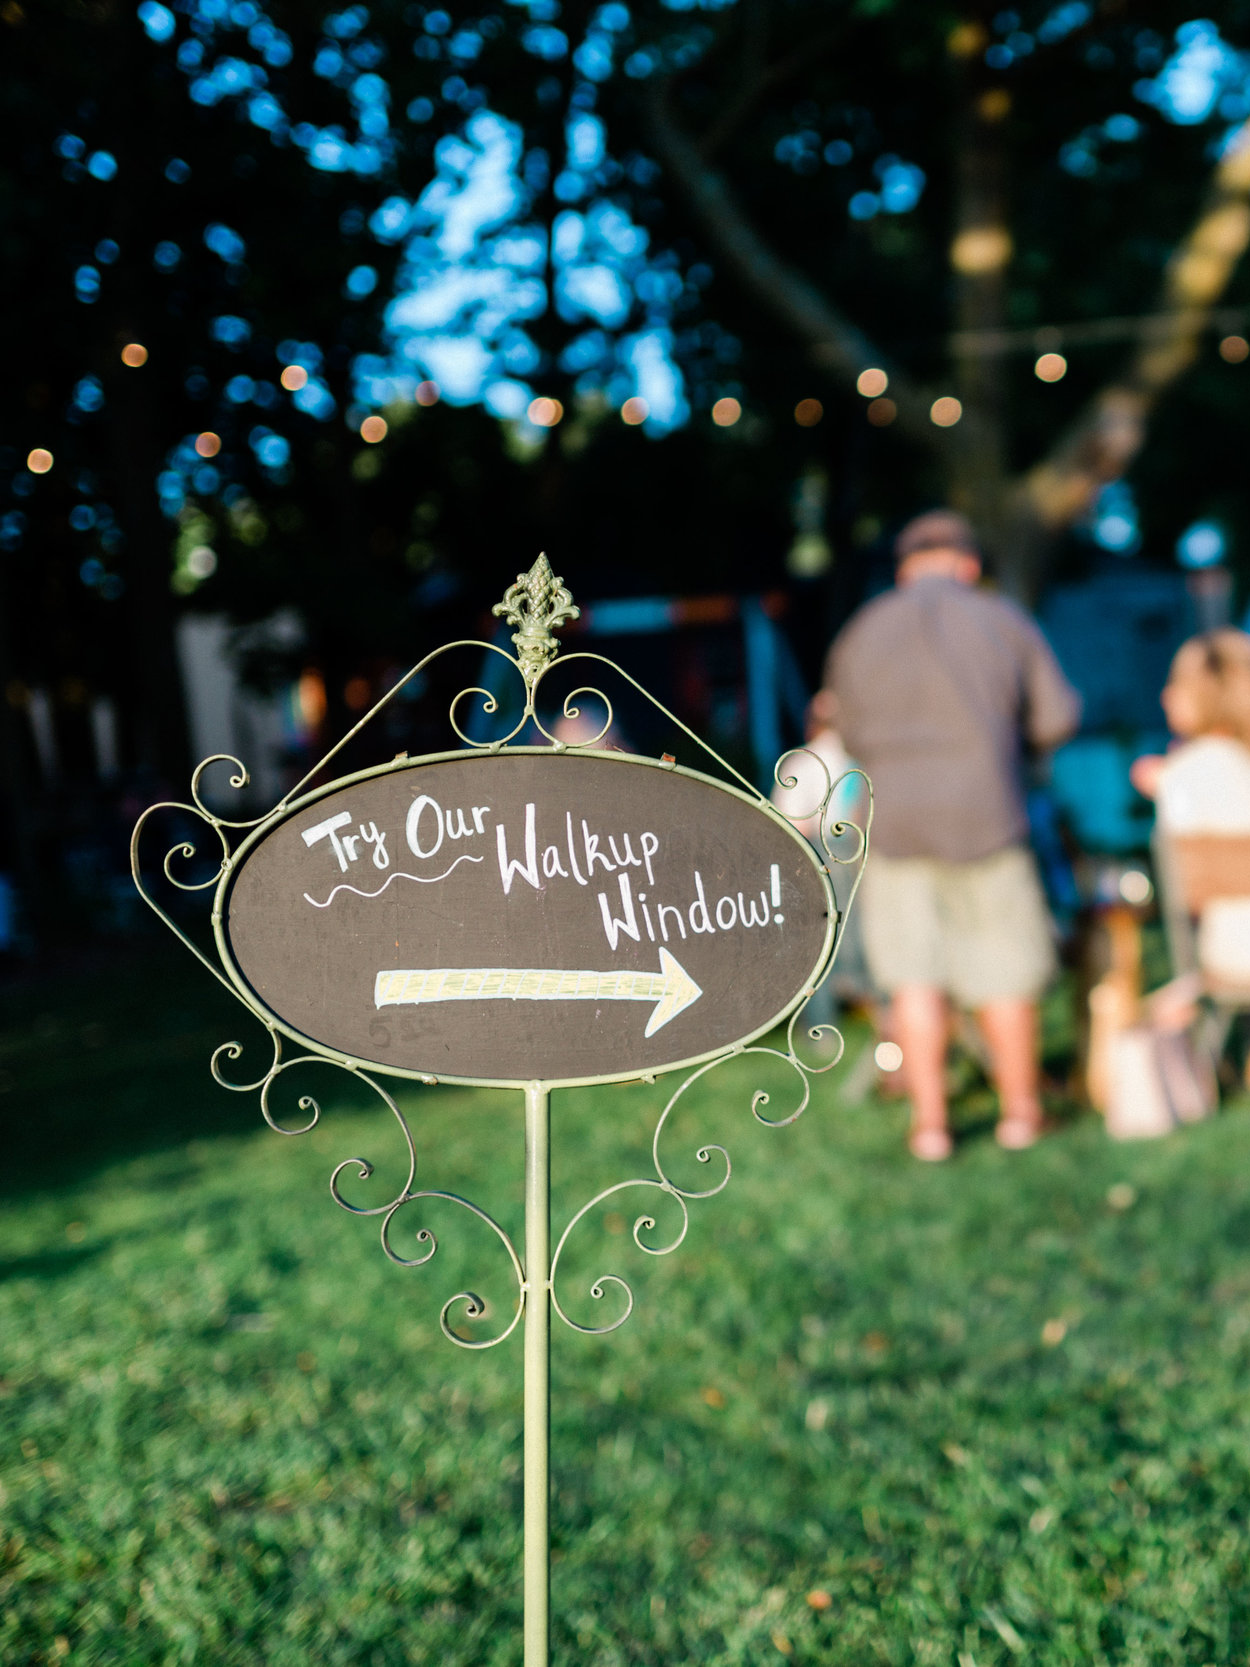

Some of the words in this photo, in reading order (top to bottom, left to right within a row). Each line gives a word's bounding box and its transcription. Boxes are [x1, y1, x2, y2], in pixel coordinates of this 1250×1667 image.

[301, 811, 389, 872] Try
[405, 794, 491, 860] Our
[495, 802, 659, 896] Walkup
[597, 863, 786, 951] Window!
